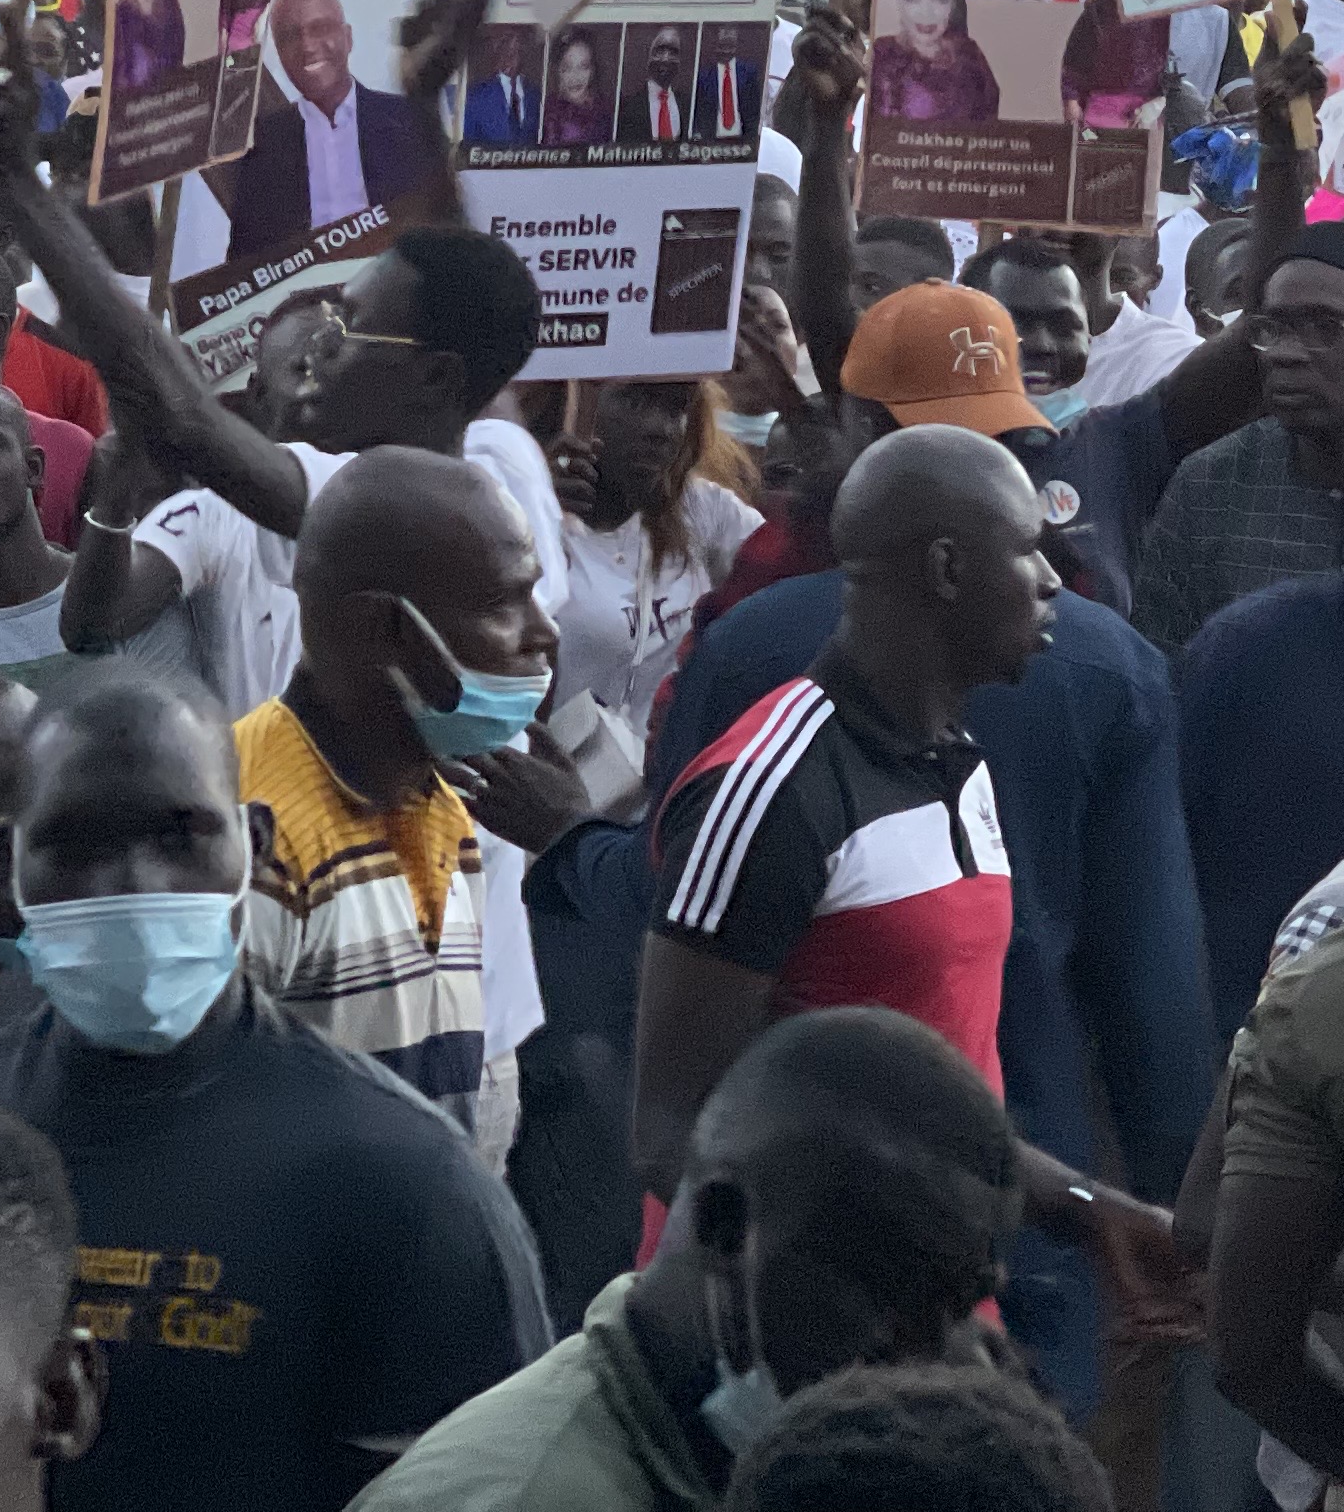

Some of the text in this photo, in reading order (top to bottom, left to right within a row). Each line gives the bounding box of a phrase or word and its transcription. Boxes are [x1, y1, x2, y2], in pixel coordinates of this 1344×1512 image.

[469, 142, 752, 165] Expérience Maturité Sagesse
[897, 131, 1031, 152] Diakhao pour un
[933, 155, 1055, 175] départemental
[891, 176, 922, 191] fort
[926, 179, 944, 192] et
[491, 214, 617, 239] Ensemble
[198, 204, 390, 316] Papa Biram TOURE
[538, 247, 637, 272] SERVIR
[538, 281, 649, 307] mune de
[536, 319, 600, 344] khao
